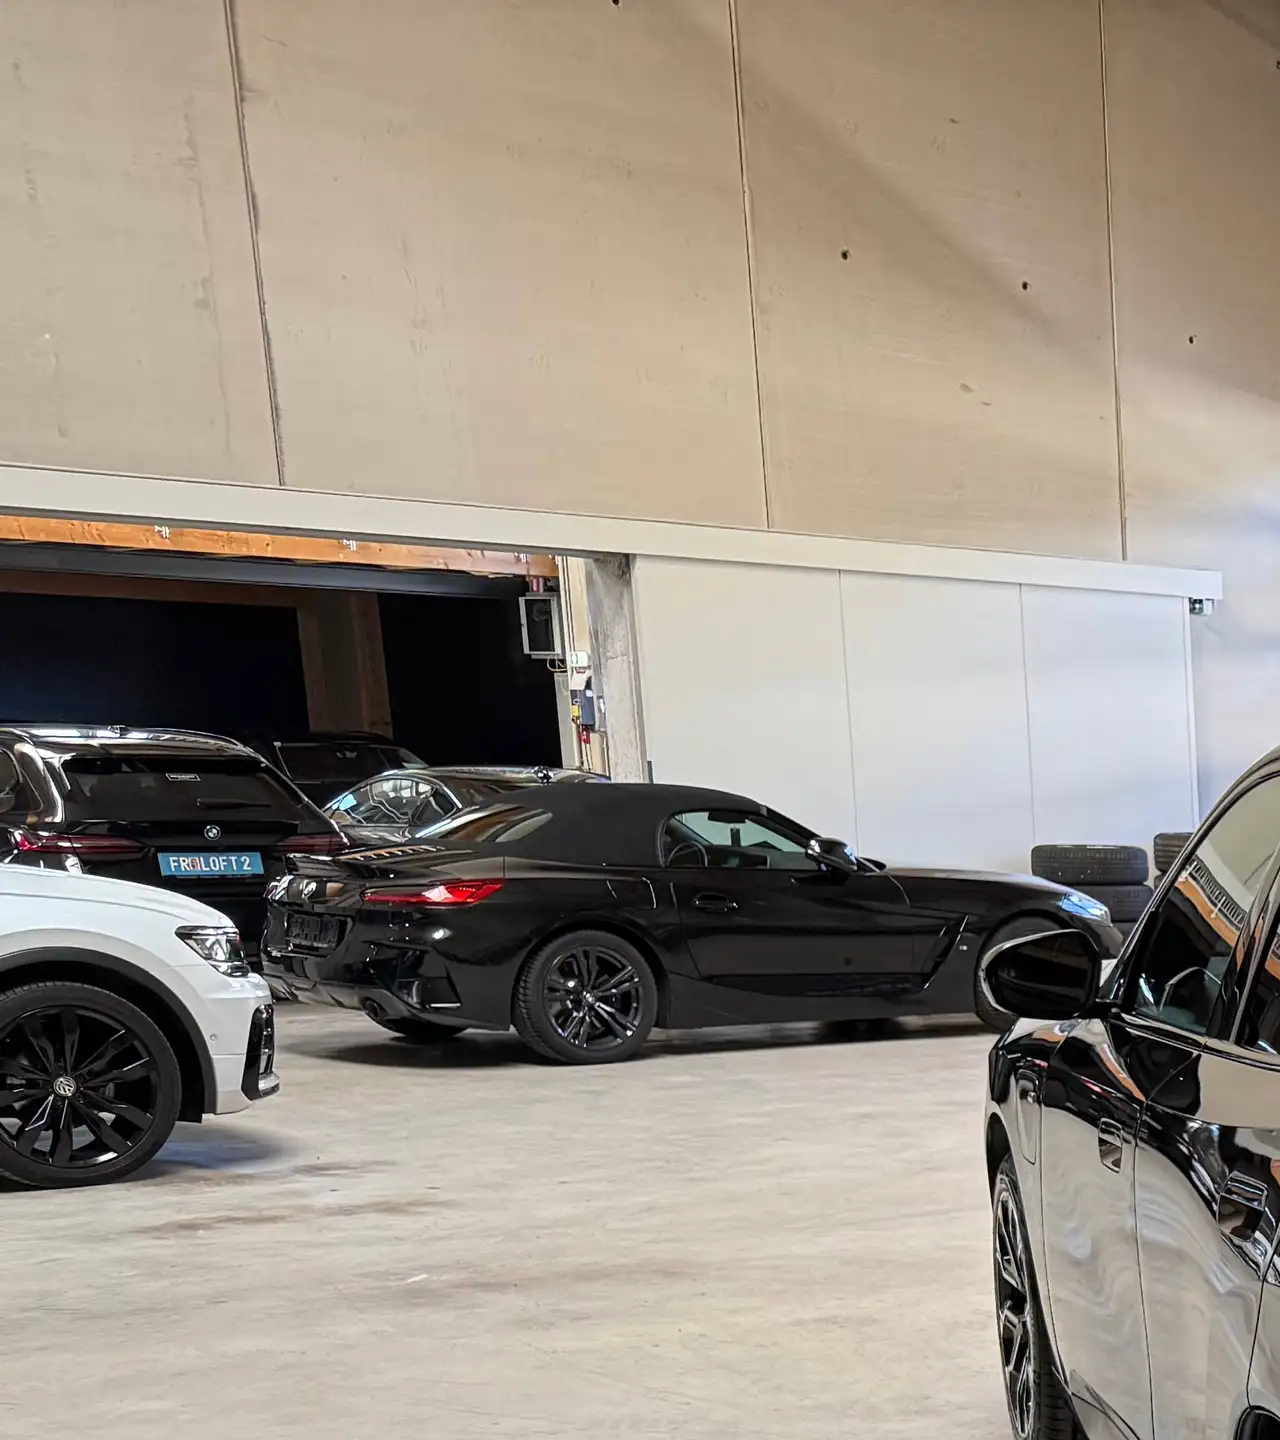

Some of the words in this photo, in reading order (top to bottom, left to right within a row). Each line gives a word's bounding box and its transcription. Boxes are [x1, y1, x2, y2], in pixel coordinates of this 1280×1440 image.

[169, 856, 190, 872] FR
[199, 856, 237, 871] LOFT
[241, 856, 252, 870] 2
